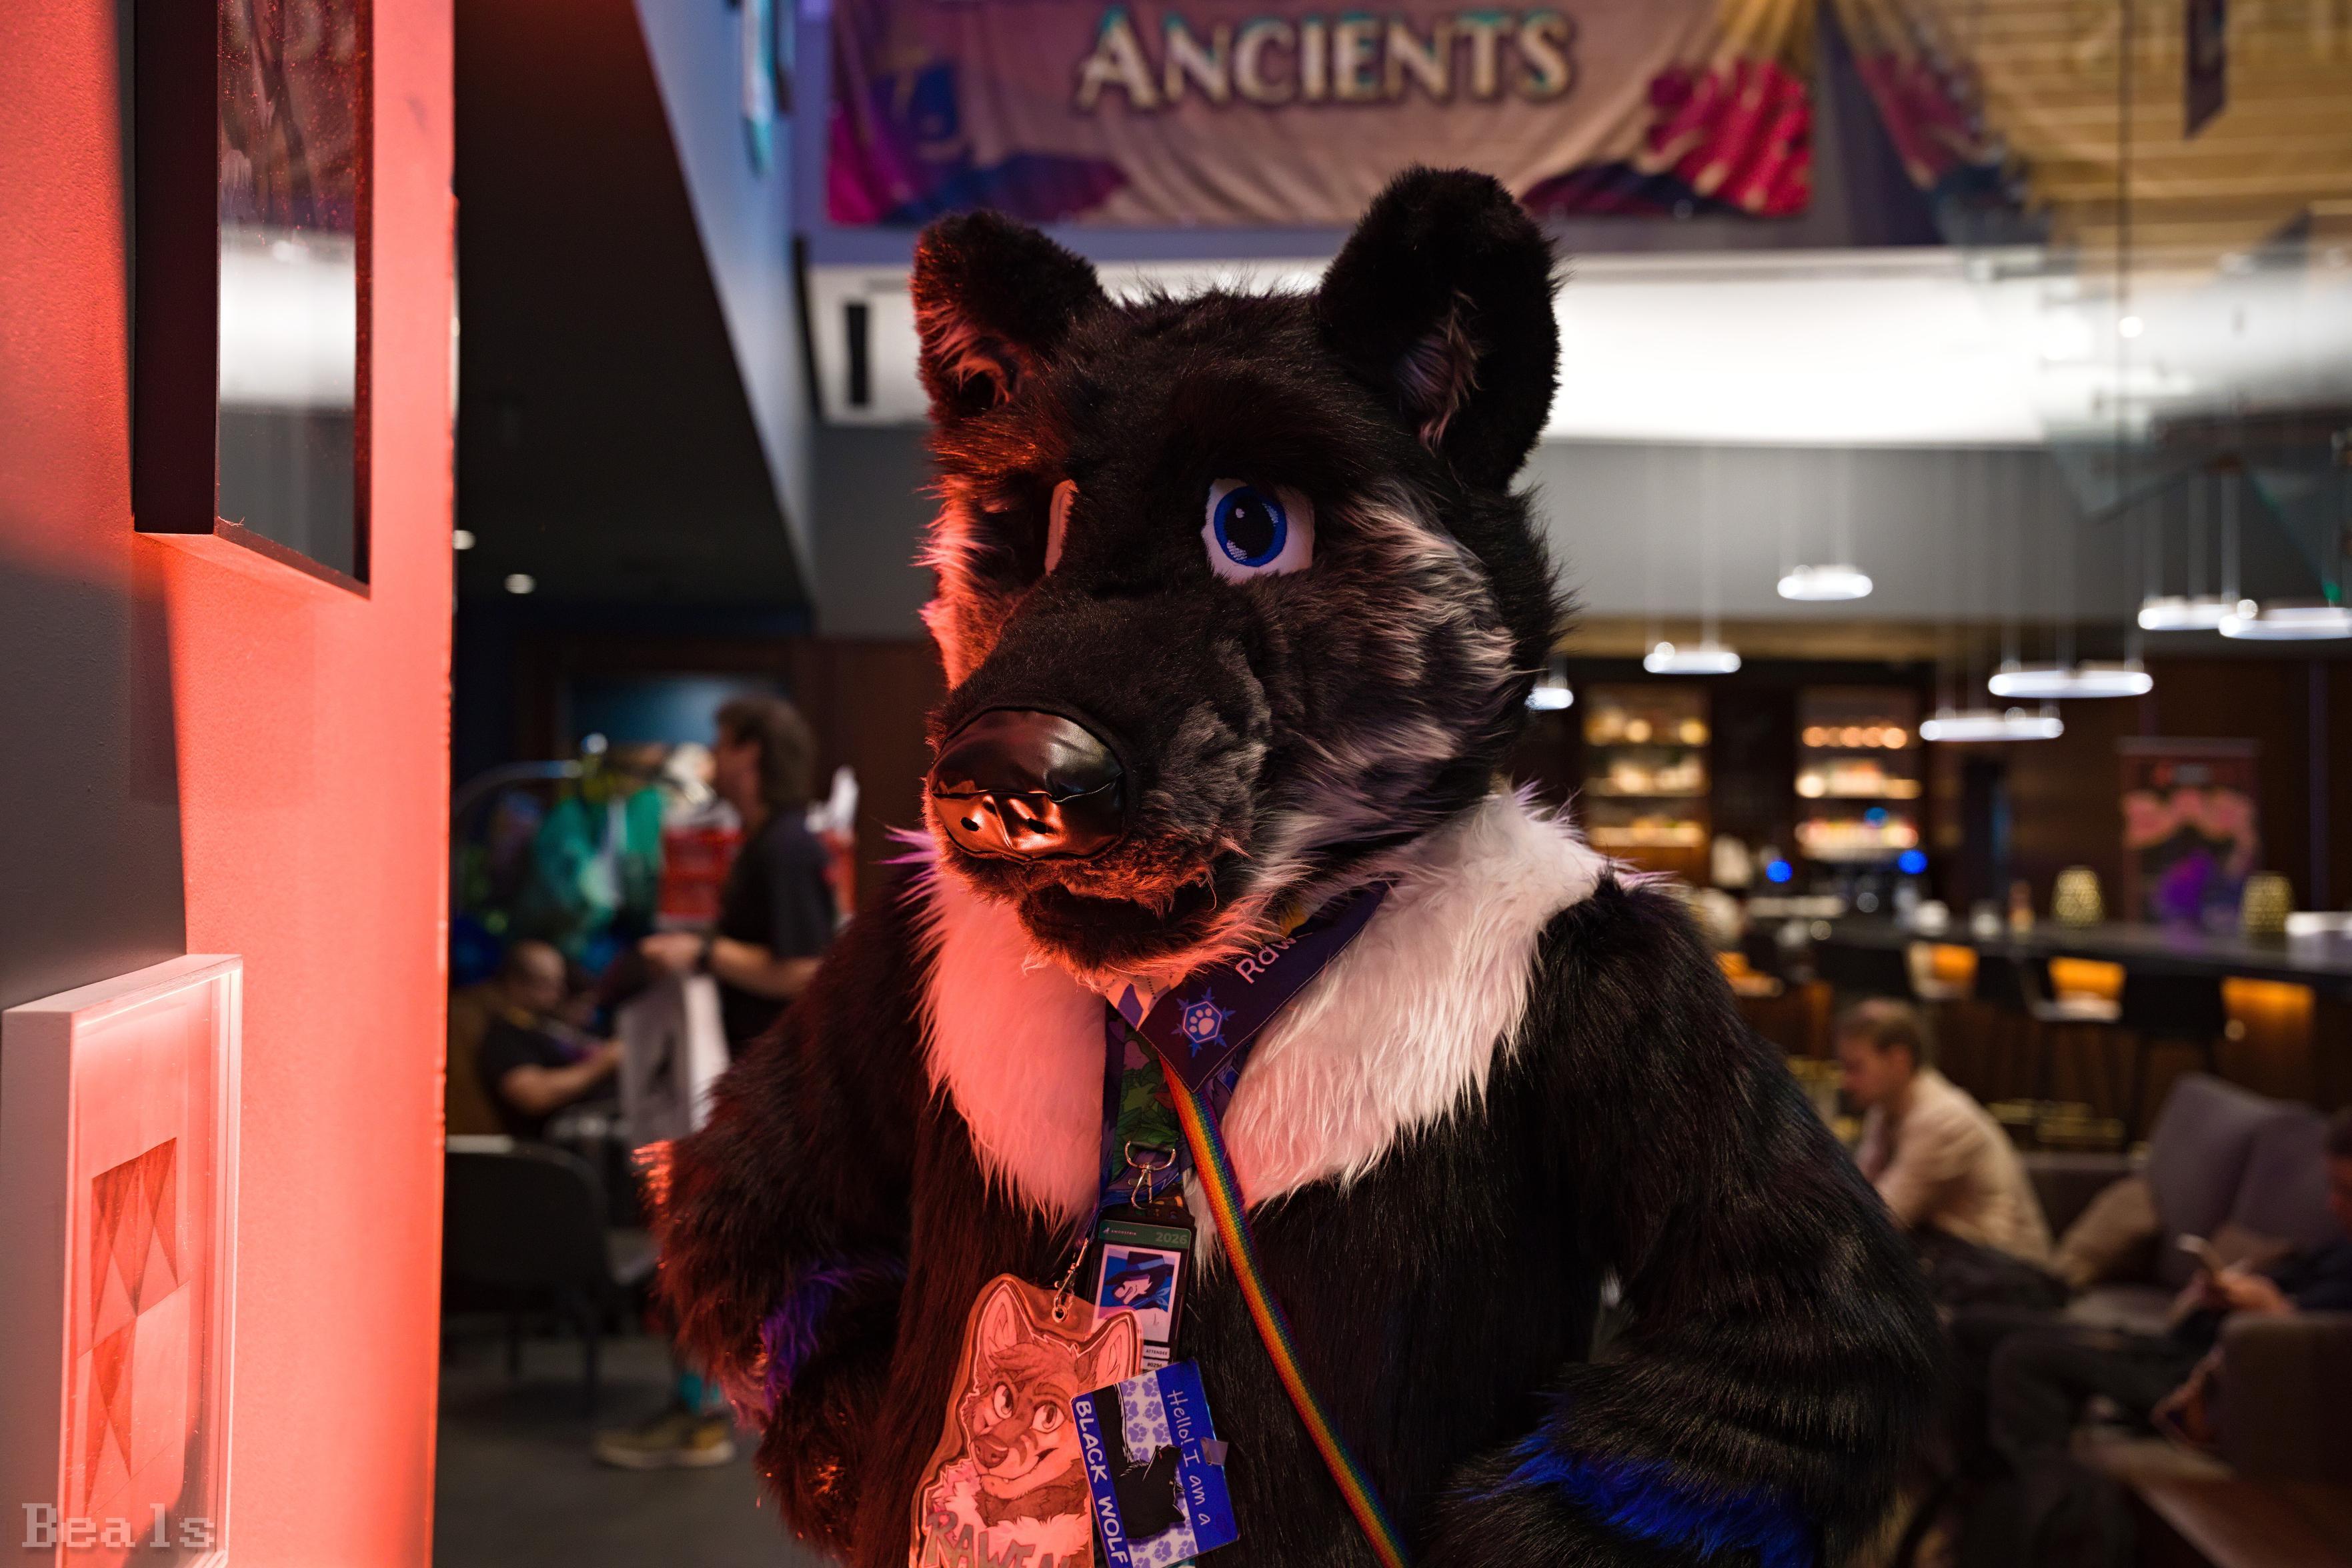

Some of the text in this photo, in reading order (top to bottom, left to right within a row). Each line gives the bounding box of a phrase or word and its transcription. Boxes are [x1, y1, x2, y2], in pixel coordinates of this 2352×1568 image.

[1077, 5, 1569, 109] ANCIENTS
[1156, 1231, 1187, 1245] 2026
[1075, 1400, 1129, 1564] BLACK WOLF
[1168, 1389, 1210, 1525] Hello! I am a
